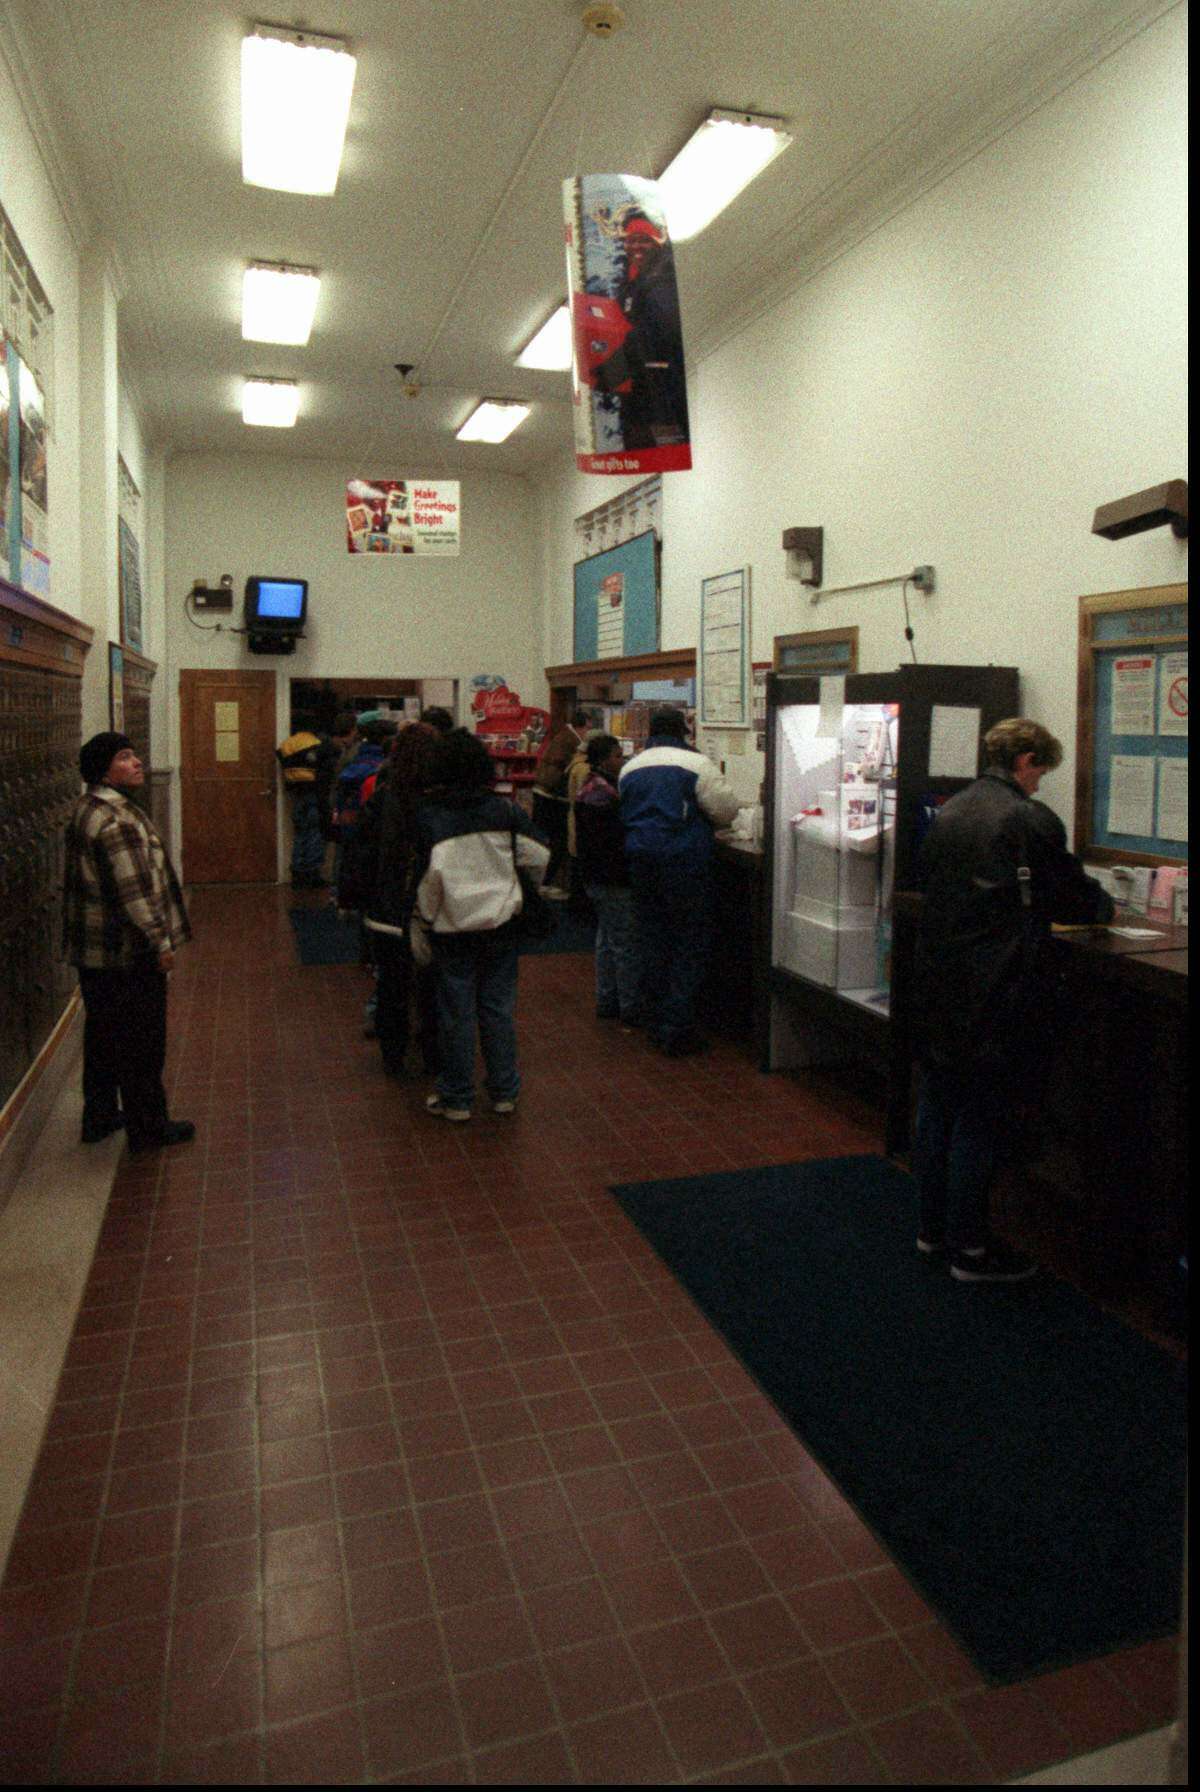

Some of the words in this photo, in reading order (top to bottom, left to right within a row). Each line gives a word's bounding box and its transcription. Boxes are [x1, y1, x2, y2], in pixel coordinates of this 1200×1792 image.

[414, 488, 437, 499] Make
[414, 500, 457, 513] Greetings
[414, 512, 443, 527] Bright
